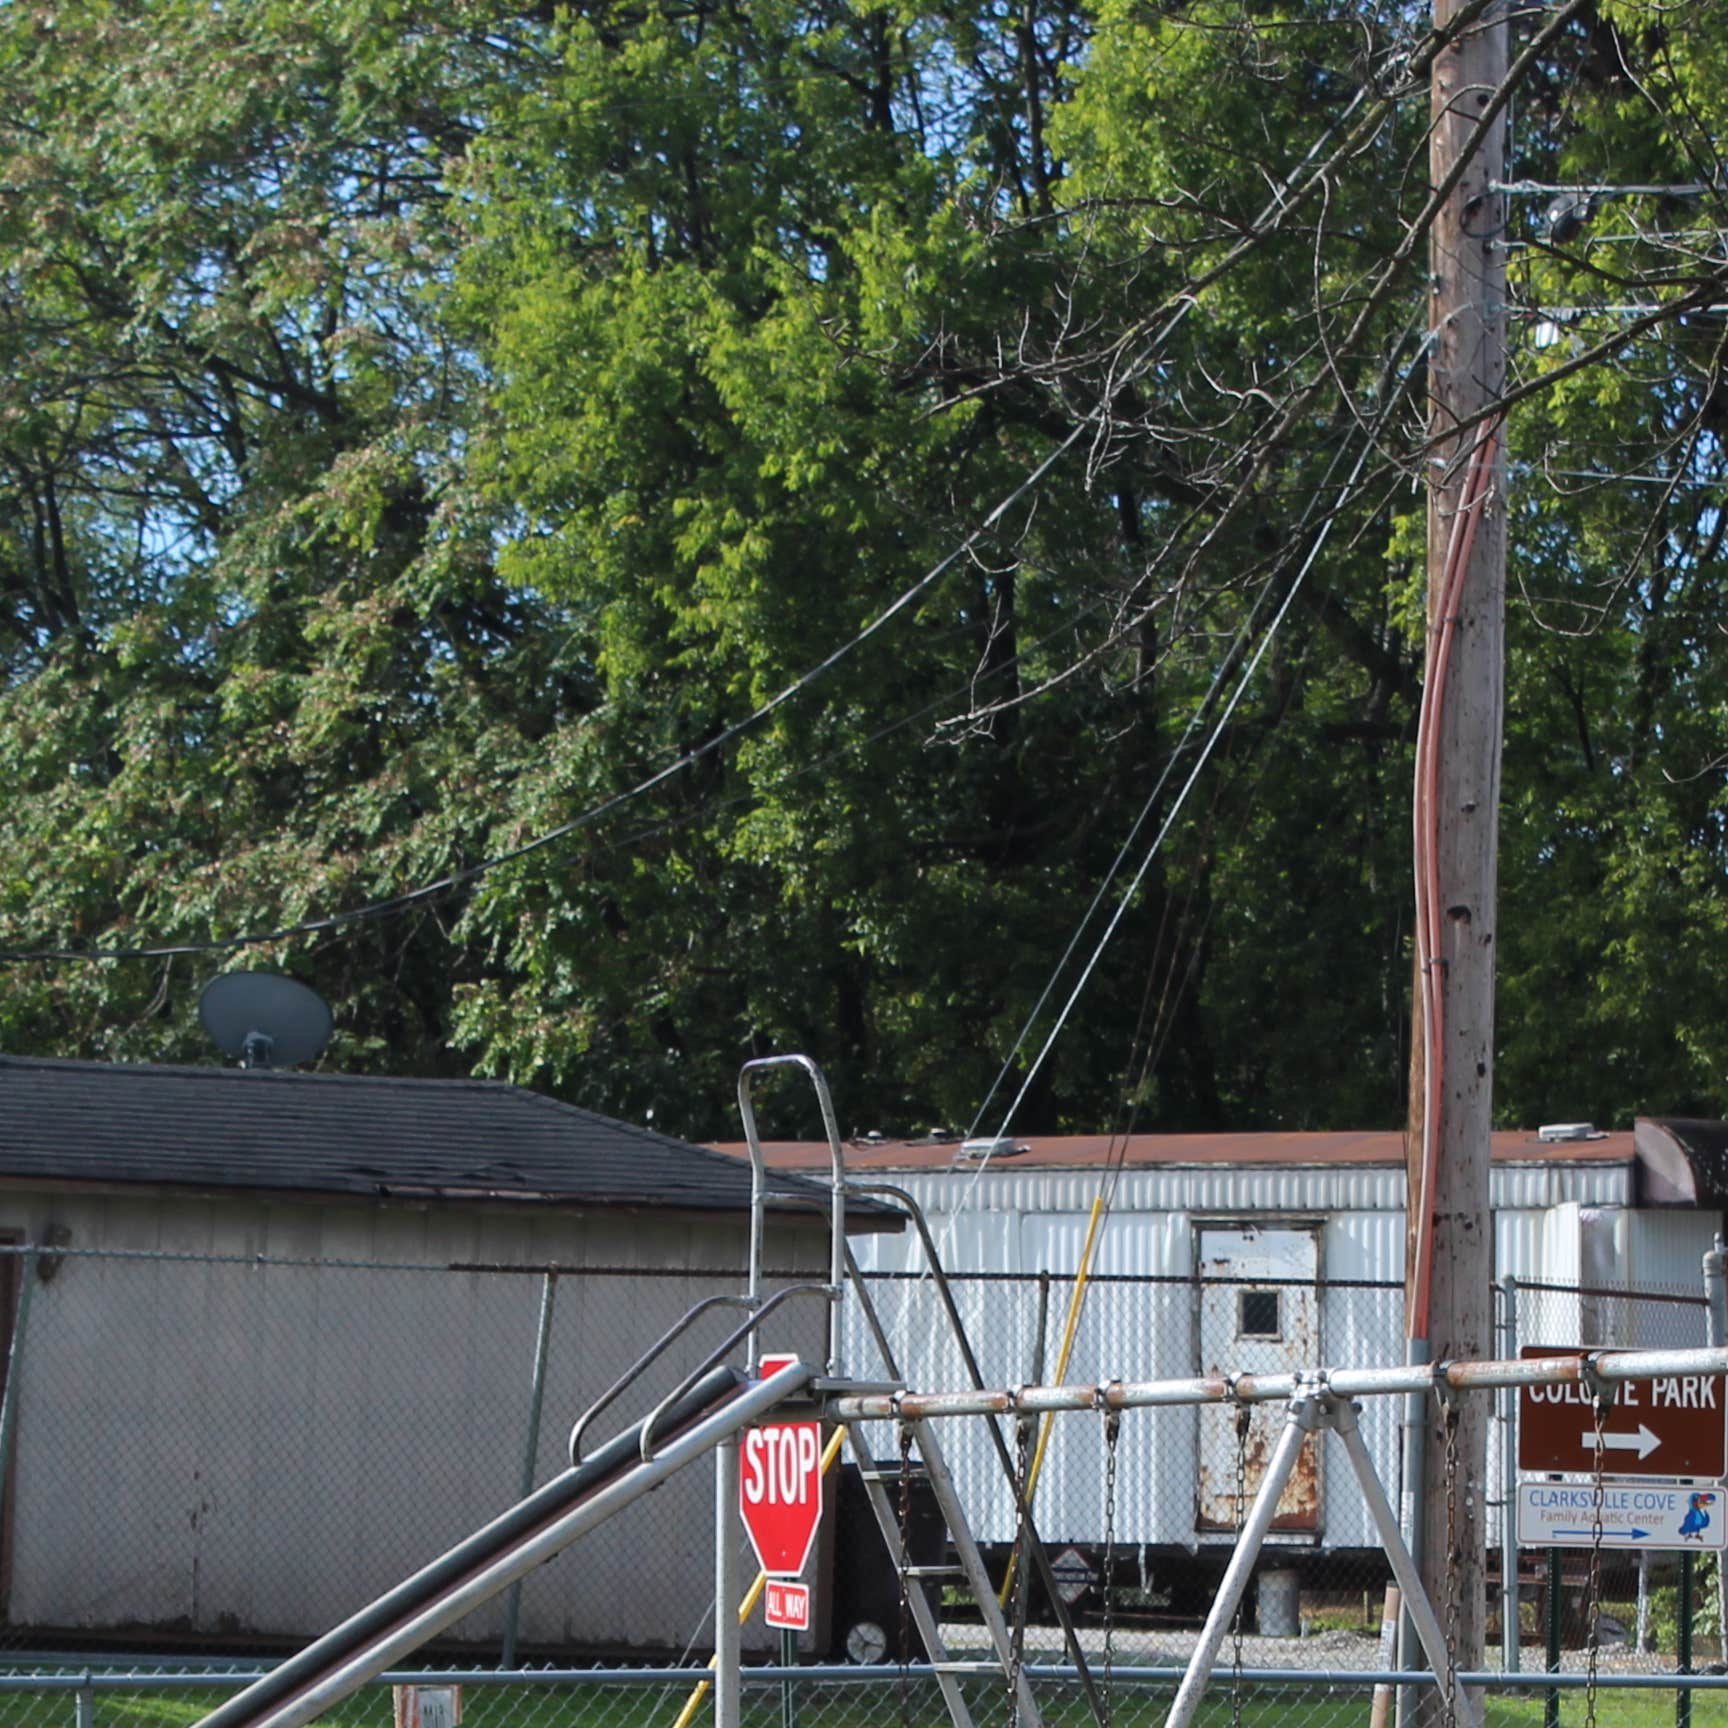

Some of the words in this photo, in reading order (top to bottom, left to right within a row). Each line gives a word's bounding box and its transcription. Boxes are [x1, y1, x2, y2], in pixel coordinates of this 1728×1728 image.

[1651, 1375, 1718, 1410] PARK
[745, 1427, 816, 1505] STOP
[1528, 1489, 1630, 1510] CLARKSVLLE
[1633, 1493, 1677, 1511] COVE
[1539, 1509, 1578, 1526] Family
[1626, 1511, 1665, 1526] Center
[768, 1590, 782, 1617] ALL
[785, 1593, 807, 1620] WAY
